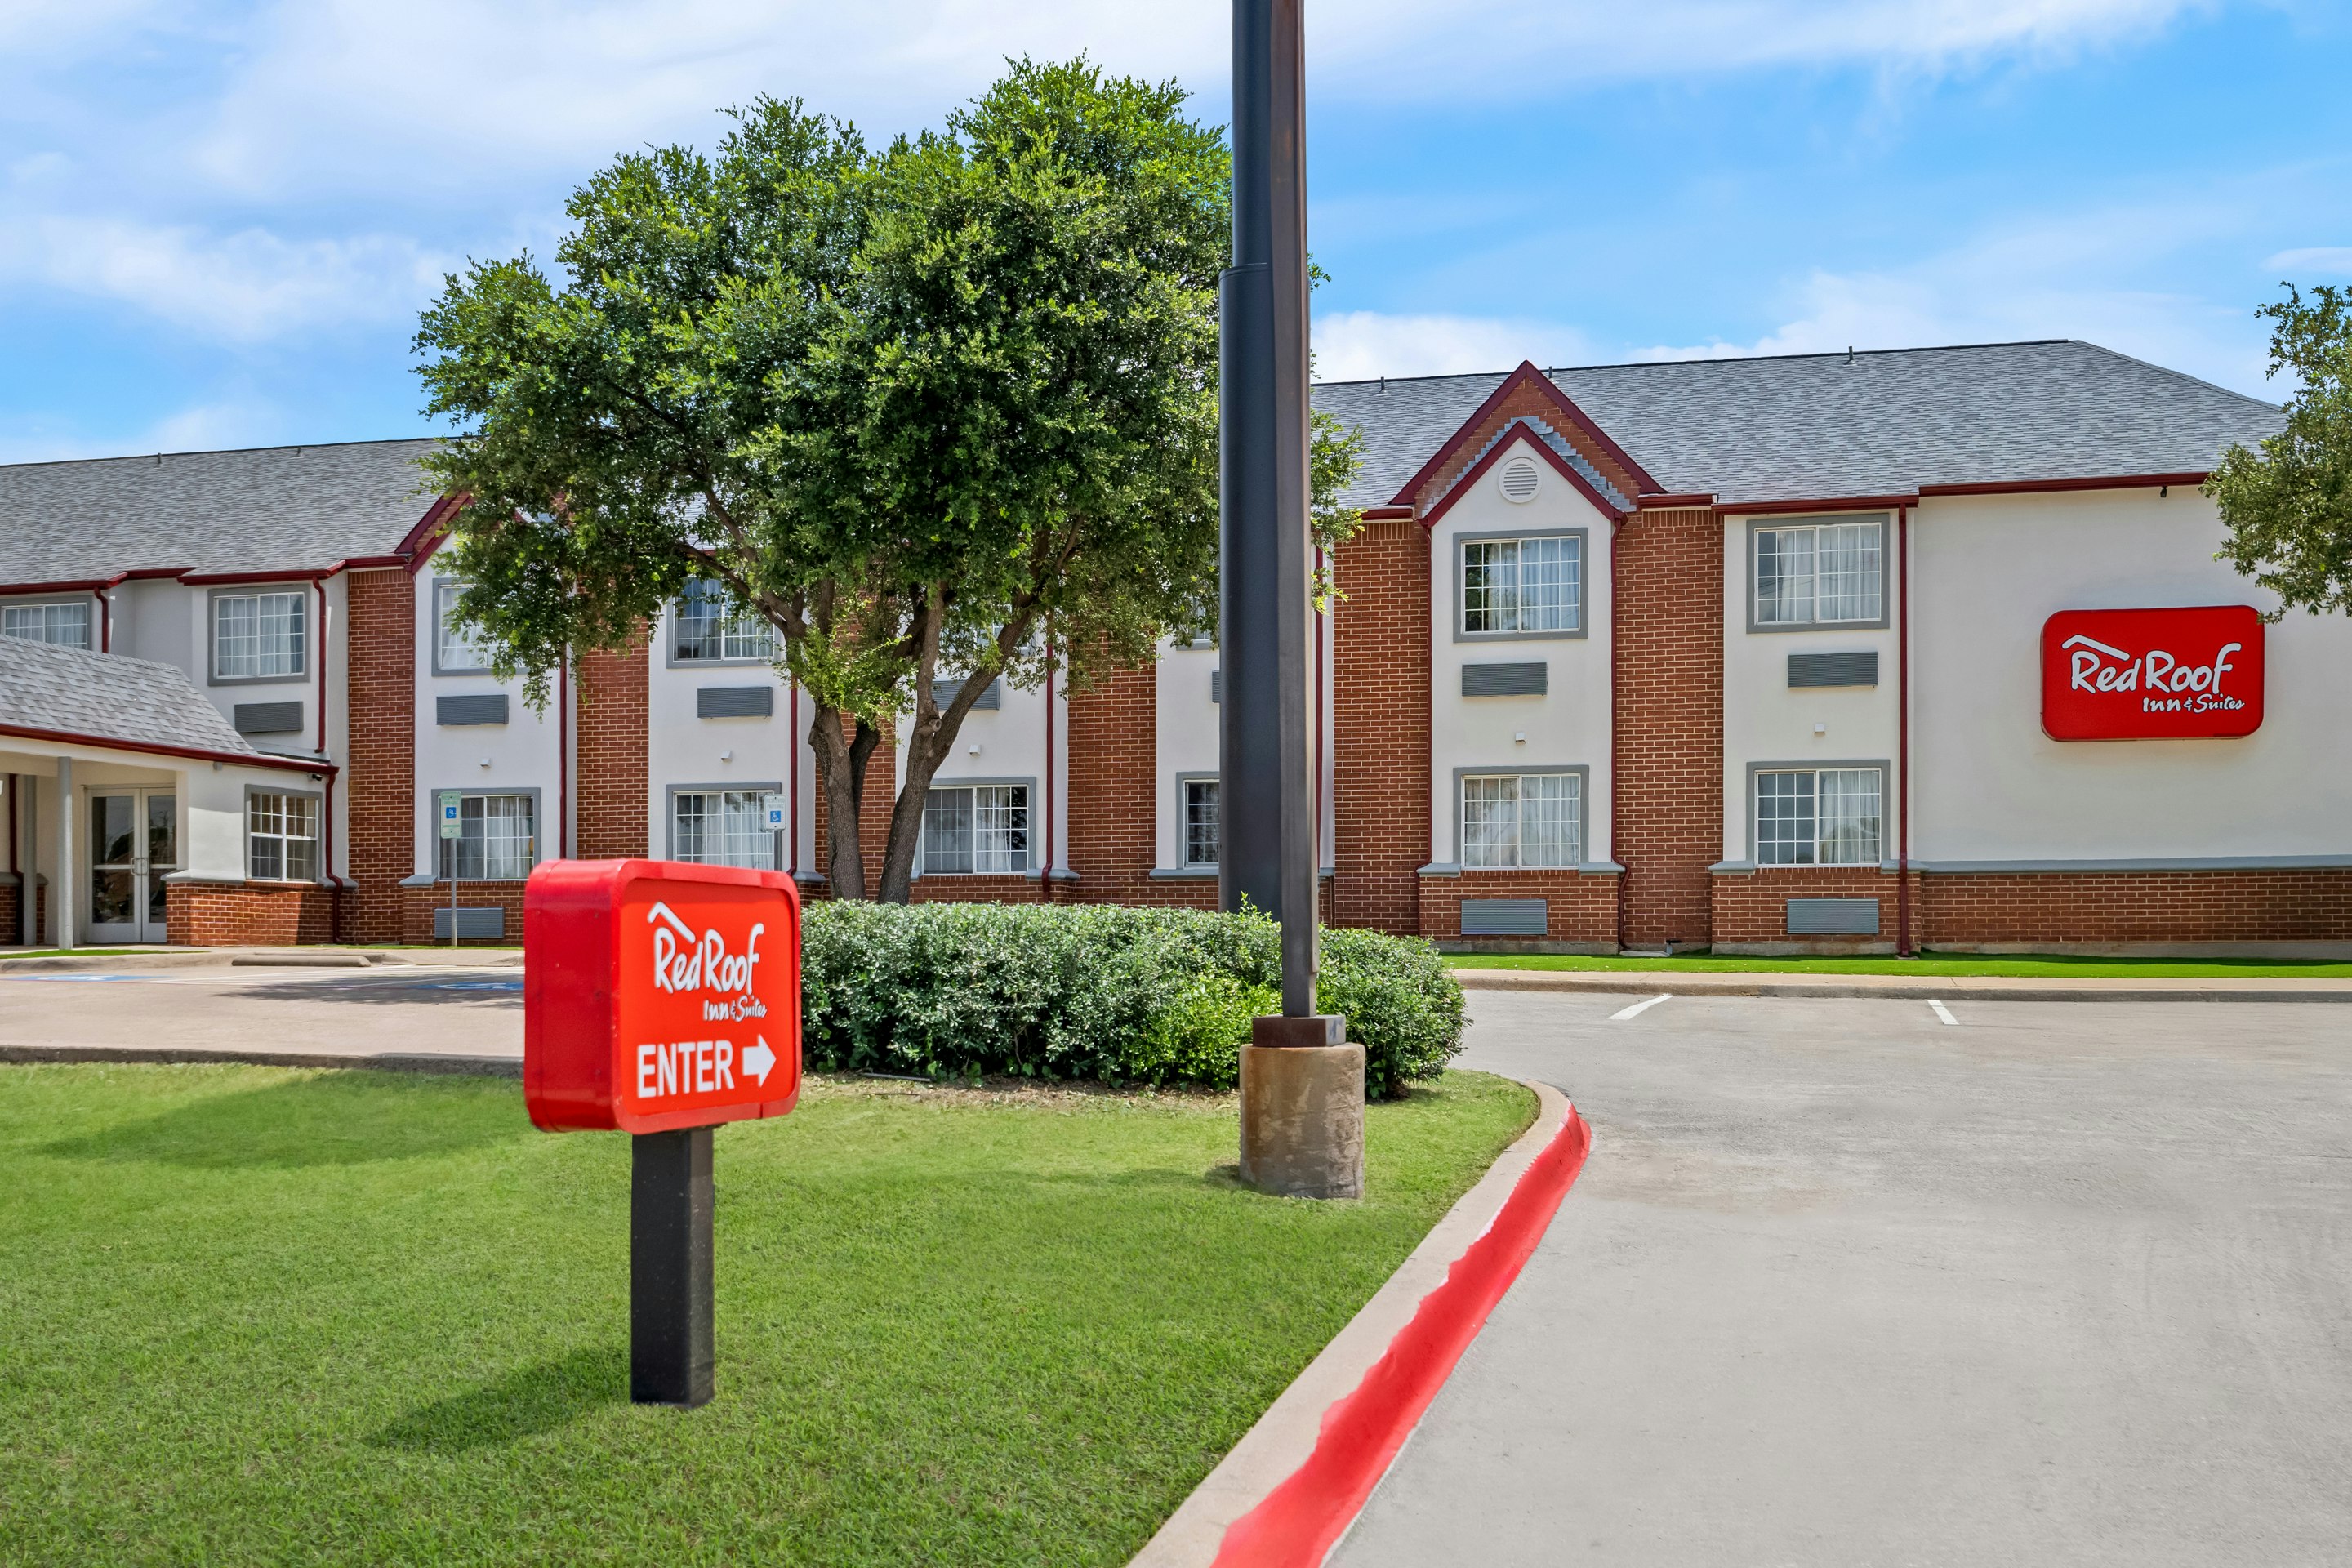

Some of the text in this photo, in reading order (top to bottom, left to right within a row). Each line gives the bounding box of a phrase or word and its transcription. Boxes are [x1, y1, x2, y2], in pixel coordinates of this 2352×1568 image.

[2071, 642, 2242, 694] Red Roof
[2143, 694, 2245, 713] Inn & Suites
[655, 923, 764, 995] Red Roof
[703, 996, 767, 1022] Inn & Suites
[637, 1040, 734, 1098] ENTER
